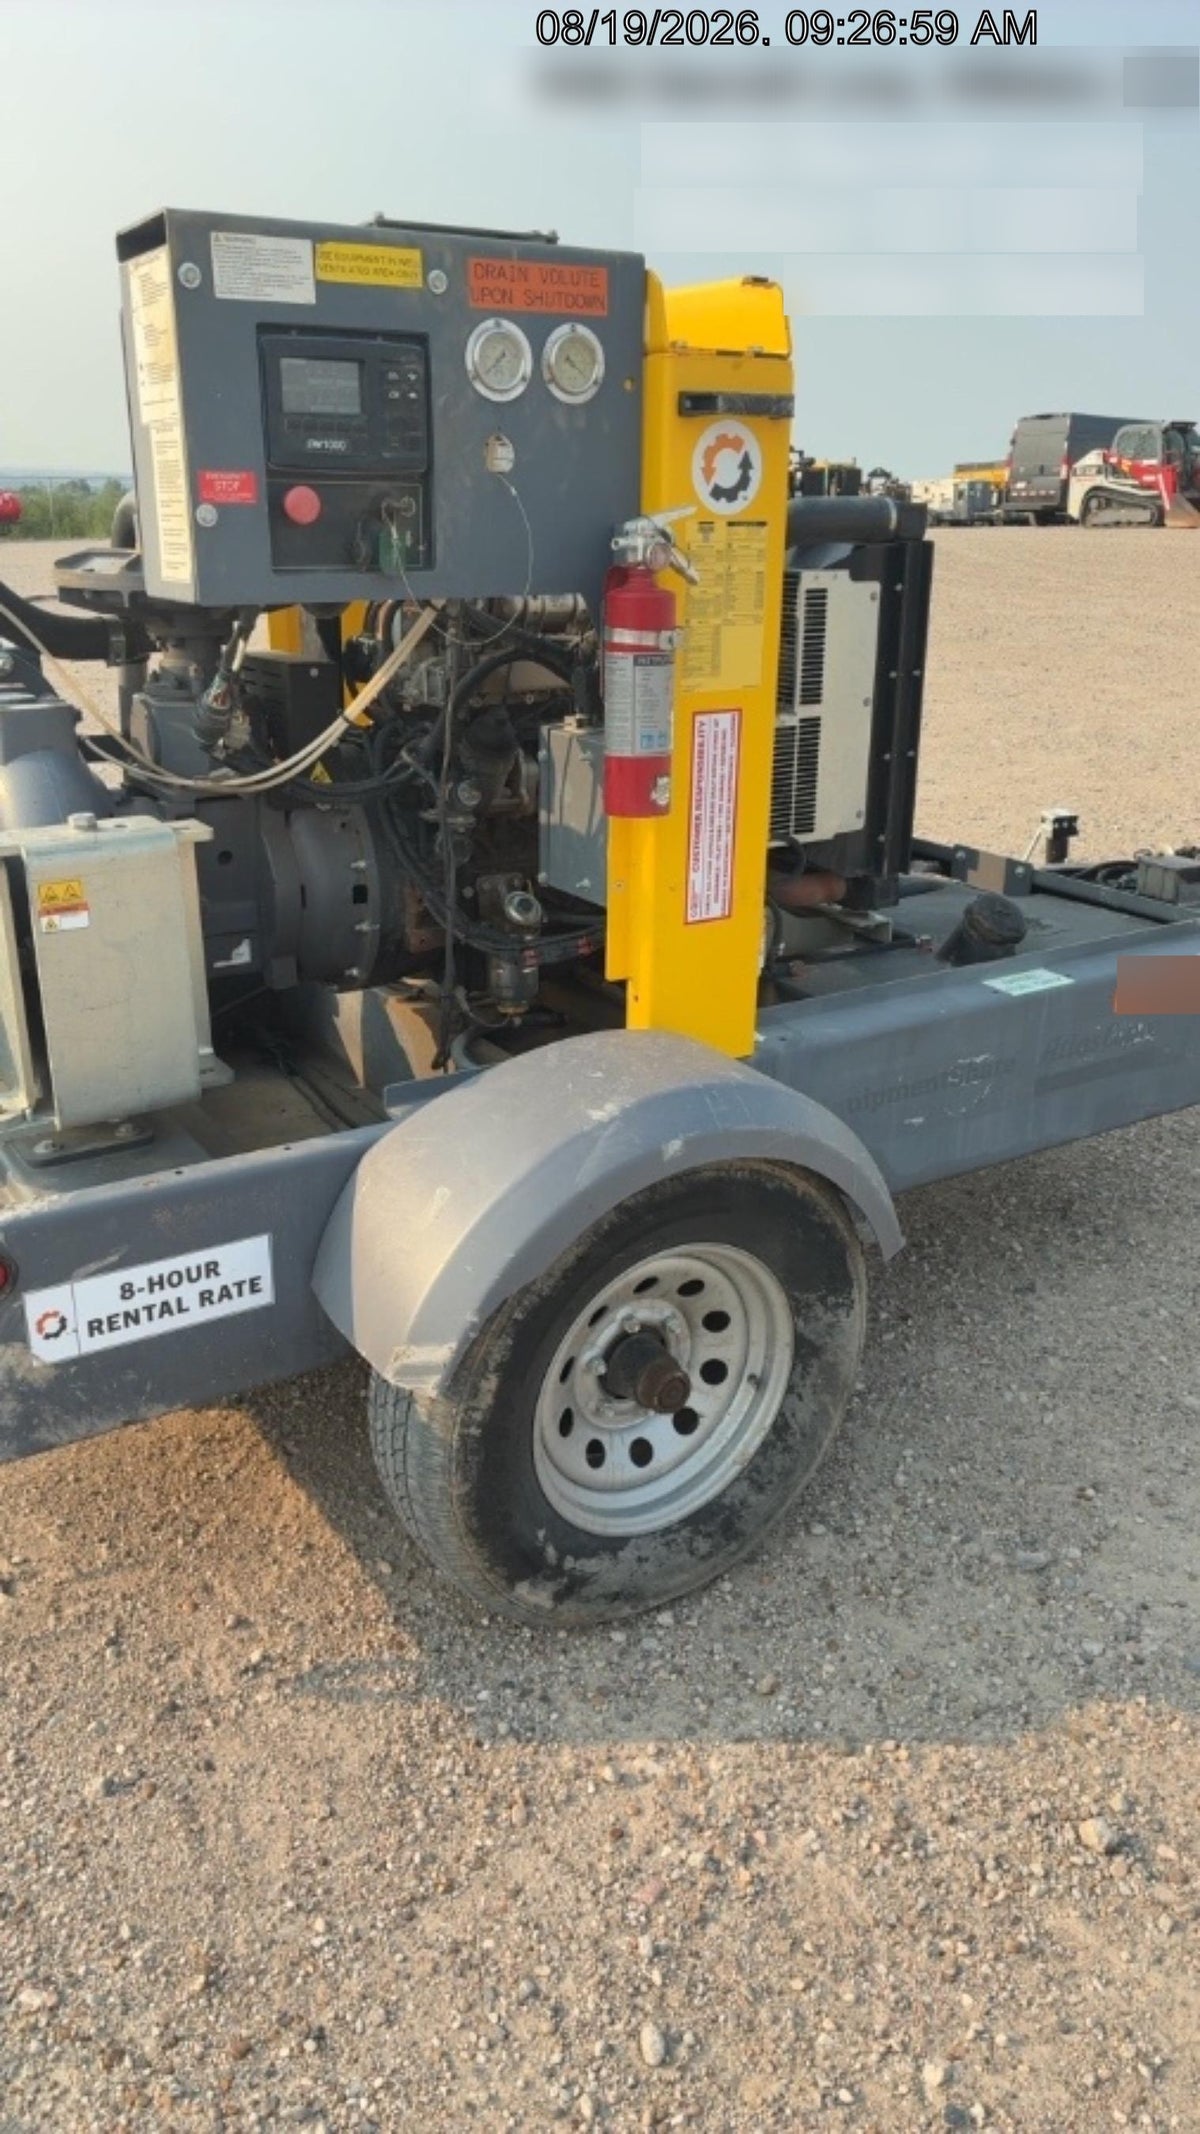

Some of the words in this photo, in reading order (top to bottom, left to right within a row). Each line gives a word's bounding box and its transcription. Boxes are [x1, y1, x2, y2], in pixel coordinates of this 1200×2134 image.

[473, 262, 529, 282] DRAIN
[538, 267, 601, 288] VOLUTE
[470, 286, 513, 305] UPON
[523, 288, 607, 311] SHUTDOWN
[213, 480, 241, 492] STOP
[693, 720, 707, 811] RESPONSIBILITY
[691, 812, 704, 875] CUSTOMER
[119, 1260, 222, 1301] 8-HOUR
[87, 1296, 190, 1338] RENTAL
[198, 1275, 263, 1308] RATE
